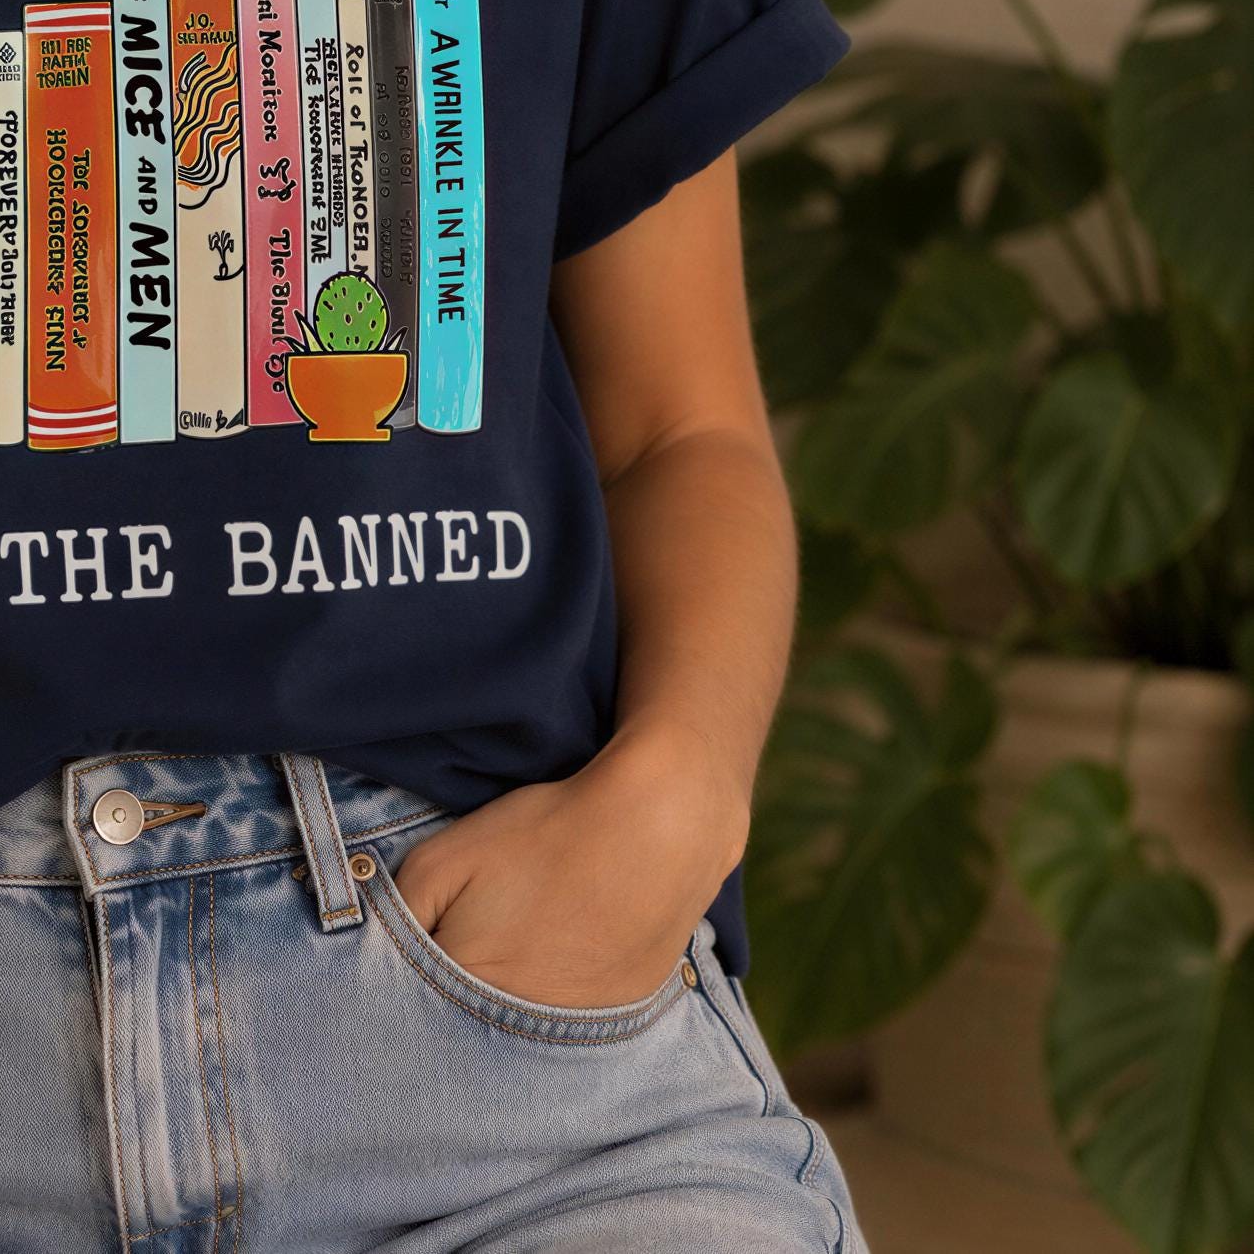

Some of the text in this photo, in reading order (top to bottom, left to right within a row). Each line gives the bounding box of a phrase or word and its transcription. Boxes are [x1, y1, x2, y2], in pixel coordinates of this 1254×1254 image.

[120, 13, 166, 144] MICE
[431, 29, 460, 54] A
[137, 156, 158, 215] AND
[438, 208, 465, 239] IN
[126, 222, 172, 350] MEN
[437, 248, 466, 323] TIME
[0, 524, 175, 606] THE
[224, 510, 533, 596] BANNED
